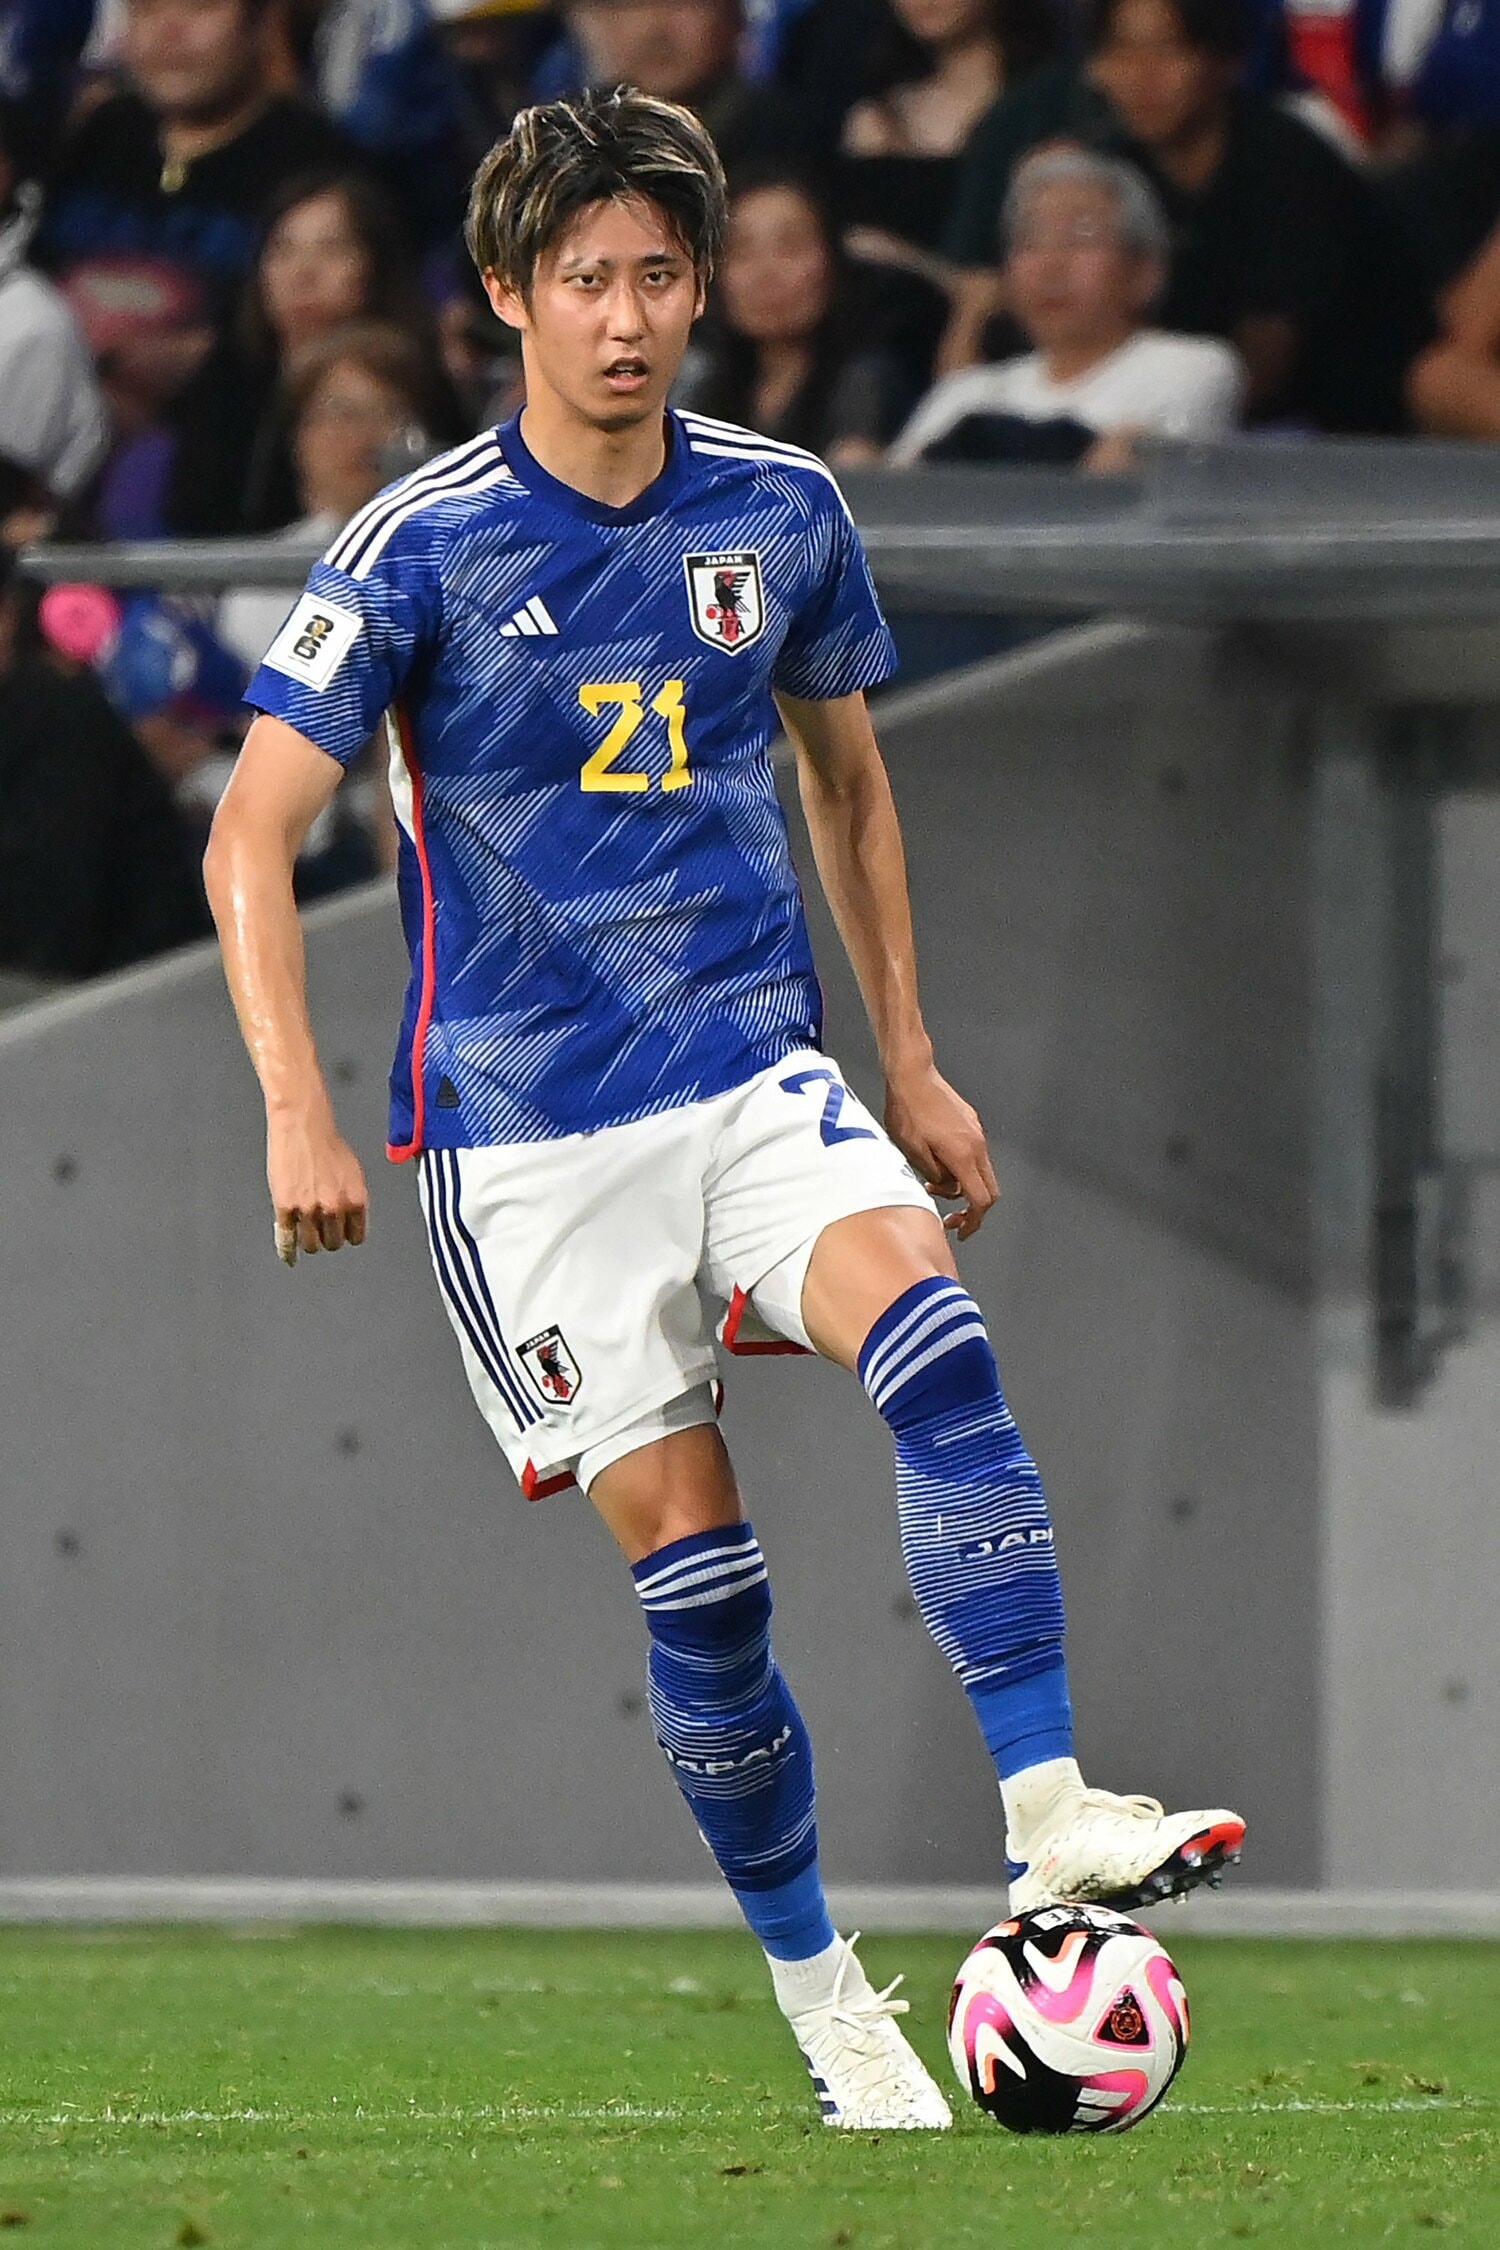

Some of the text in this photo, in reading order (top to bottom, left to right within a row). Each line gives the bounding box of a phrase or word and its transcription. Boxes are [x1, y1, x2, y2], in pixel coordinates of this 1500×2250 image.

[704, 555, 743, 566] JAPAN
[578, 679, 695, 793] 21
[771, 1068, 880, 1148] 2
[966, 1527, 1053, 1560] JAP
